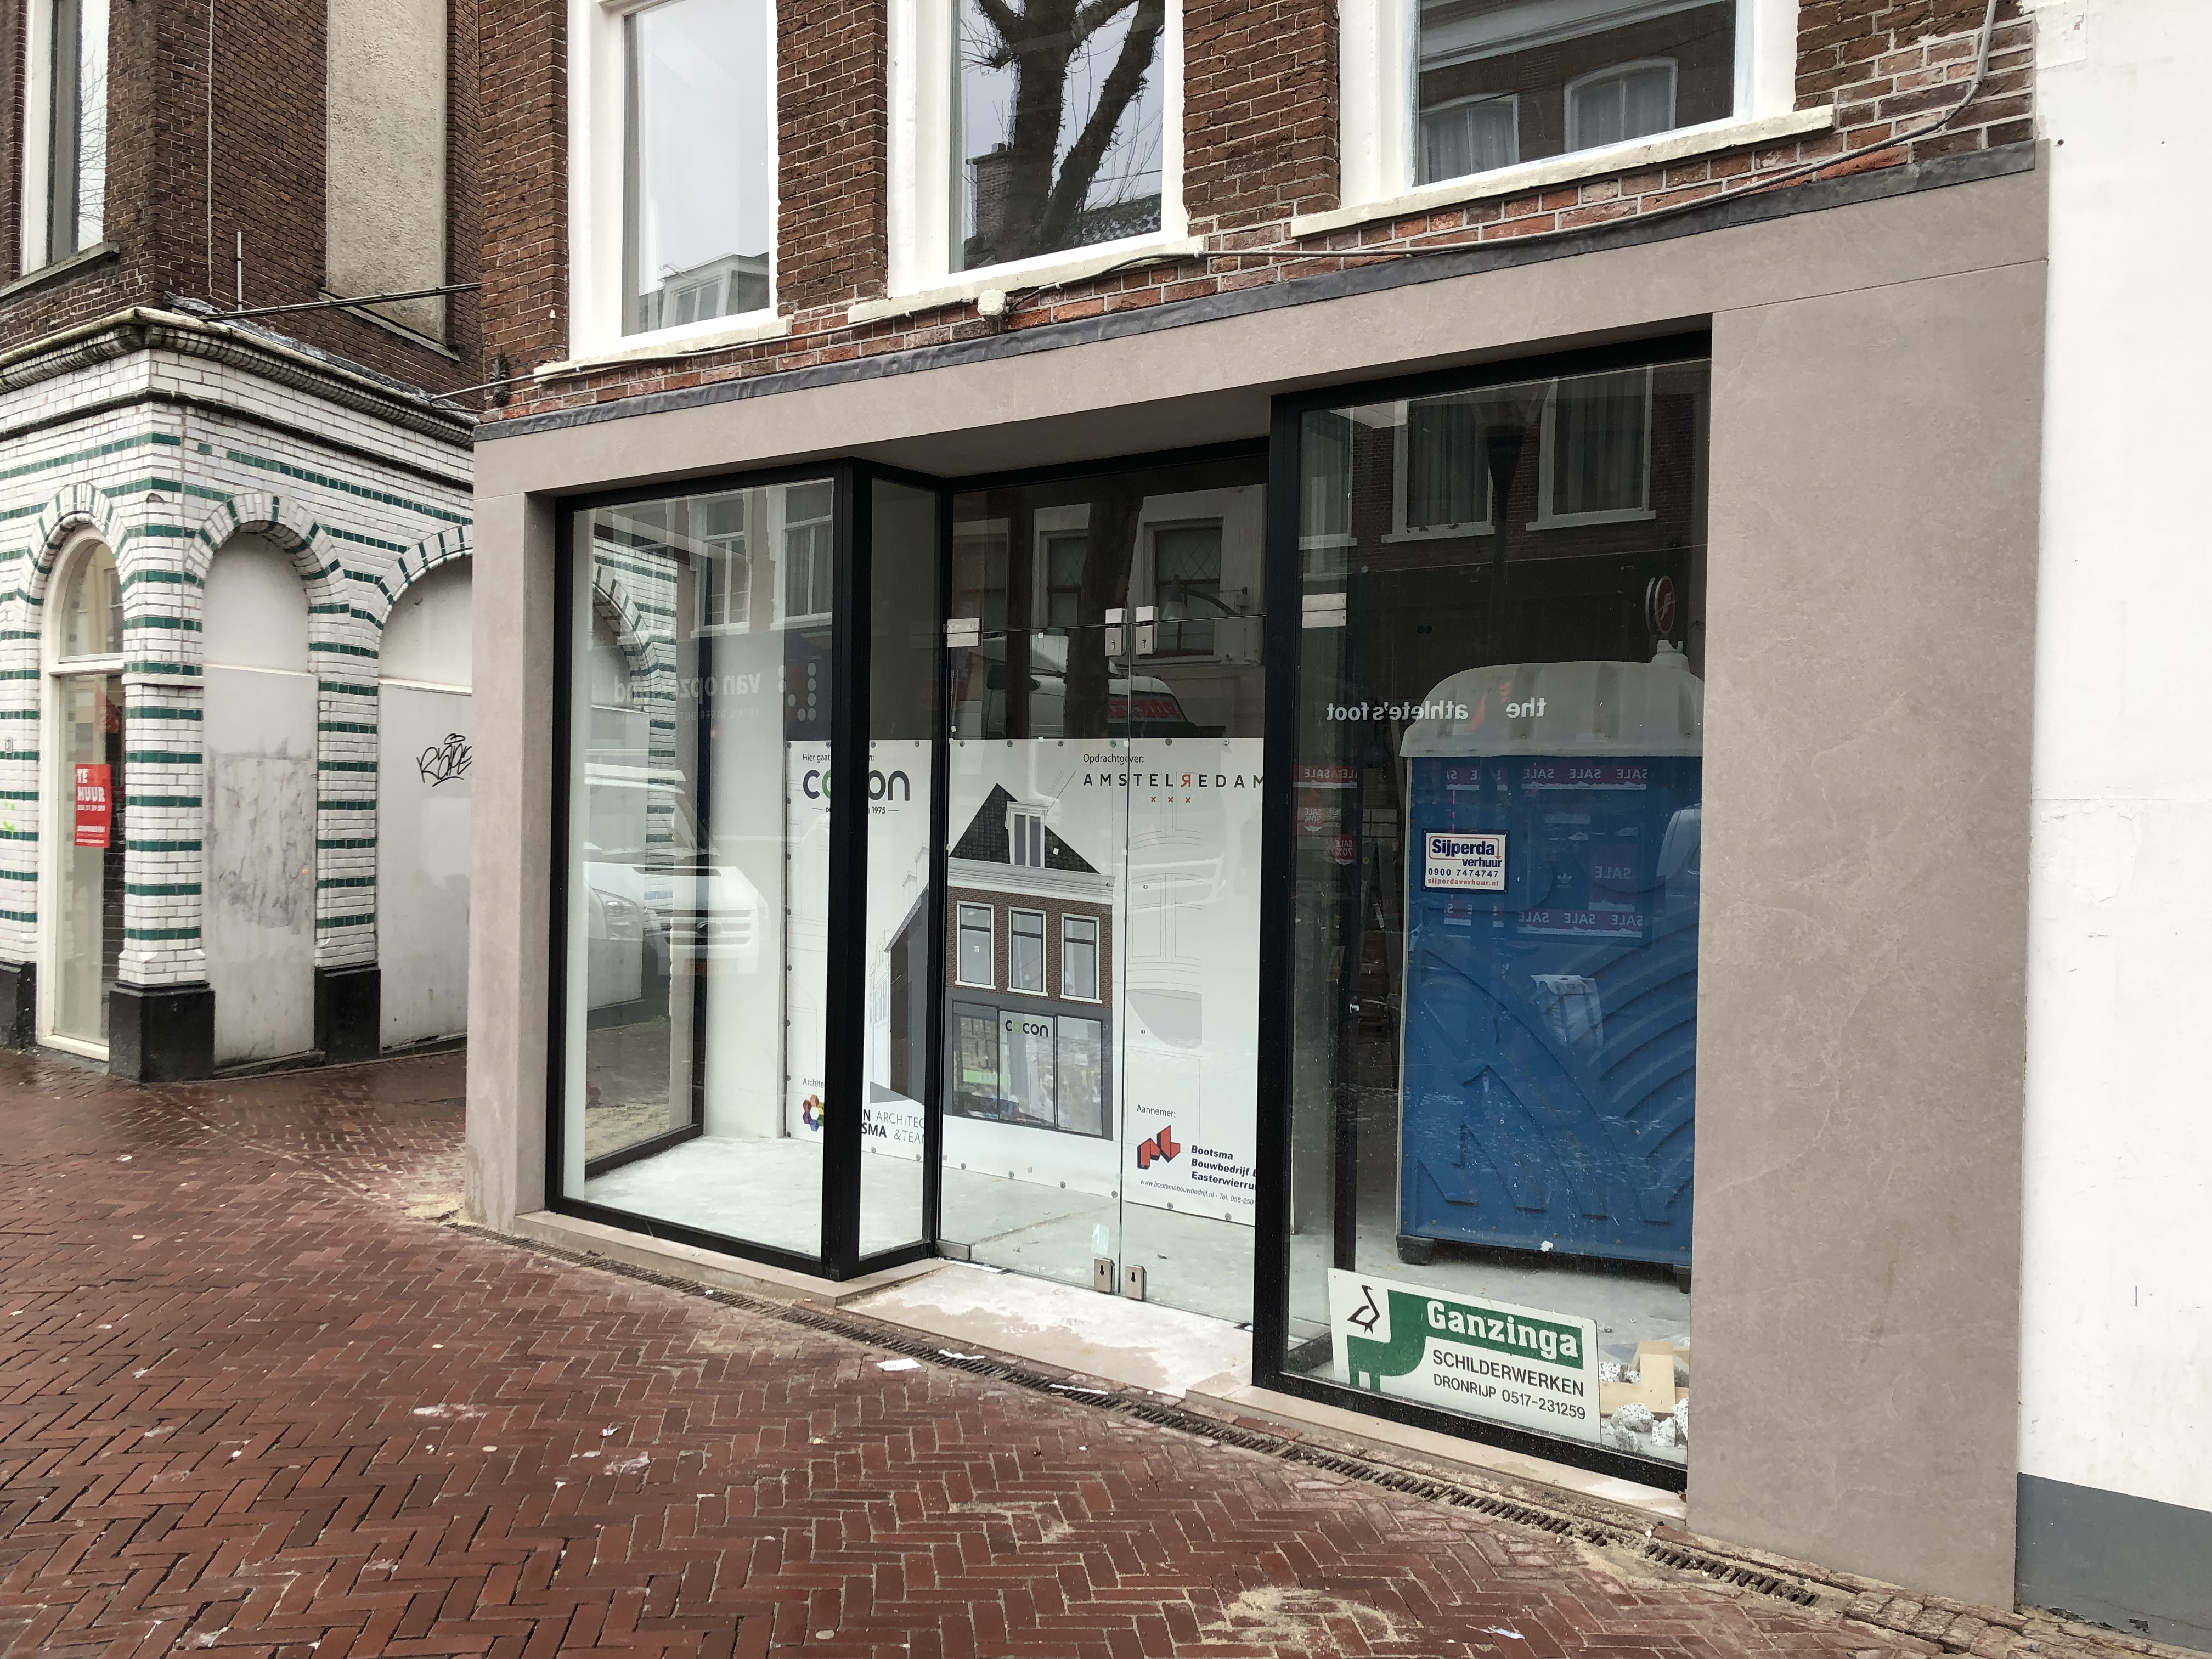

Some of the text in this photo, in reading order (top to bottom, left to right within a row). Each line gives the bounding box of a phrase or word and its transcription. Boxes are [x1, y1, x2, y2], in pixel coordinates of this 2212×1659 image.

[816, 754, 830, 763] gaat
[1083, 753, 1145, 765] Opdrachtgever:
[77, 768, 88, 783] TE
[77, 786, 106, 802] HUUR
[1432, 839, 1495, 857] Sijperda
[1462, 857, 1502, 868] verhuur
[1428, 868, 1499, 878] 0900 7474747
[1427, 878, 1499, 887] sijperdaverhuur.nl
[1005, 1020, 1049, 1037] cocon
[803, 1077, 825, 1088] Archite
[1137, 1104, 1176, 1118] Aannemer:
[876, 1111, 925, 1129] ARCHITEC
[1191, 1145, 1233, 1160] Bootsma
[1191, 1158, 1249, 1177] Bouwbedrijf
[1191, 1171, 1256, 1190] Easterwierru
[1140, 1180, 1214, 1198] www.bootsmabouwbedrijf.nl
[1230, 1195, 1255, 1205] 058-250
[1427, 1301, 1578, 1360] Ganzinga
[1433, 1349, 1584, 1397] SCHILDERWERKEN
[1434, 1373, 1585, 1420] DRONRIJP 0517-231259
